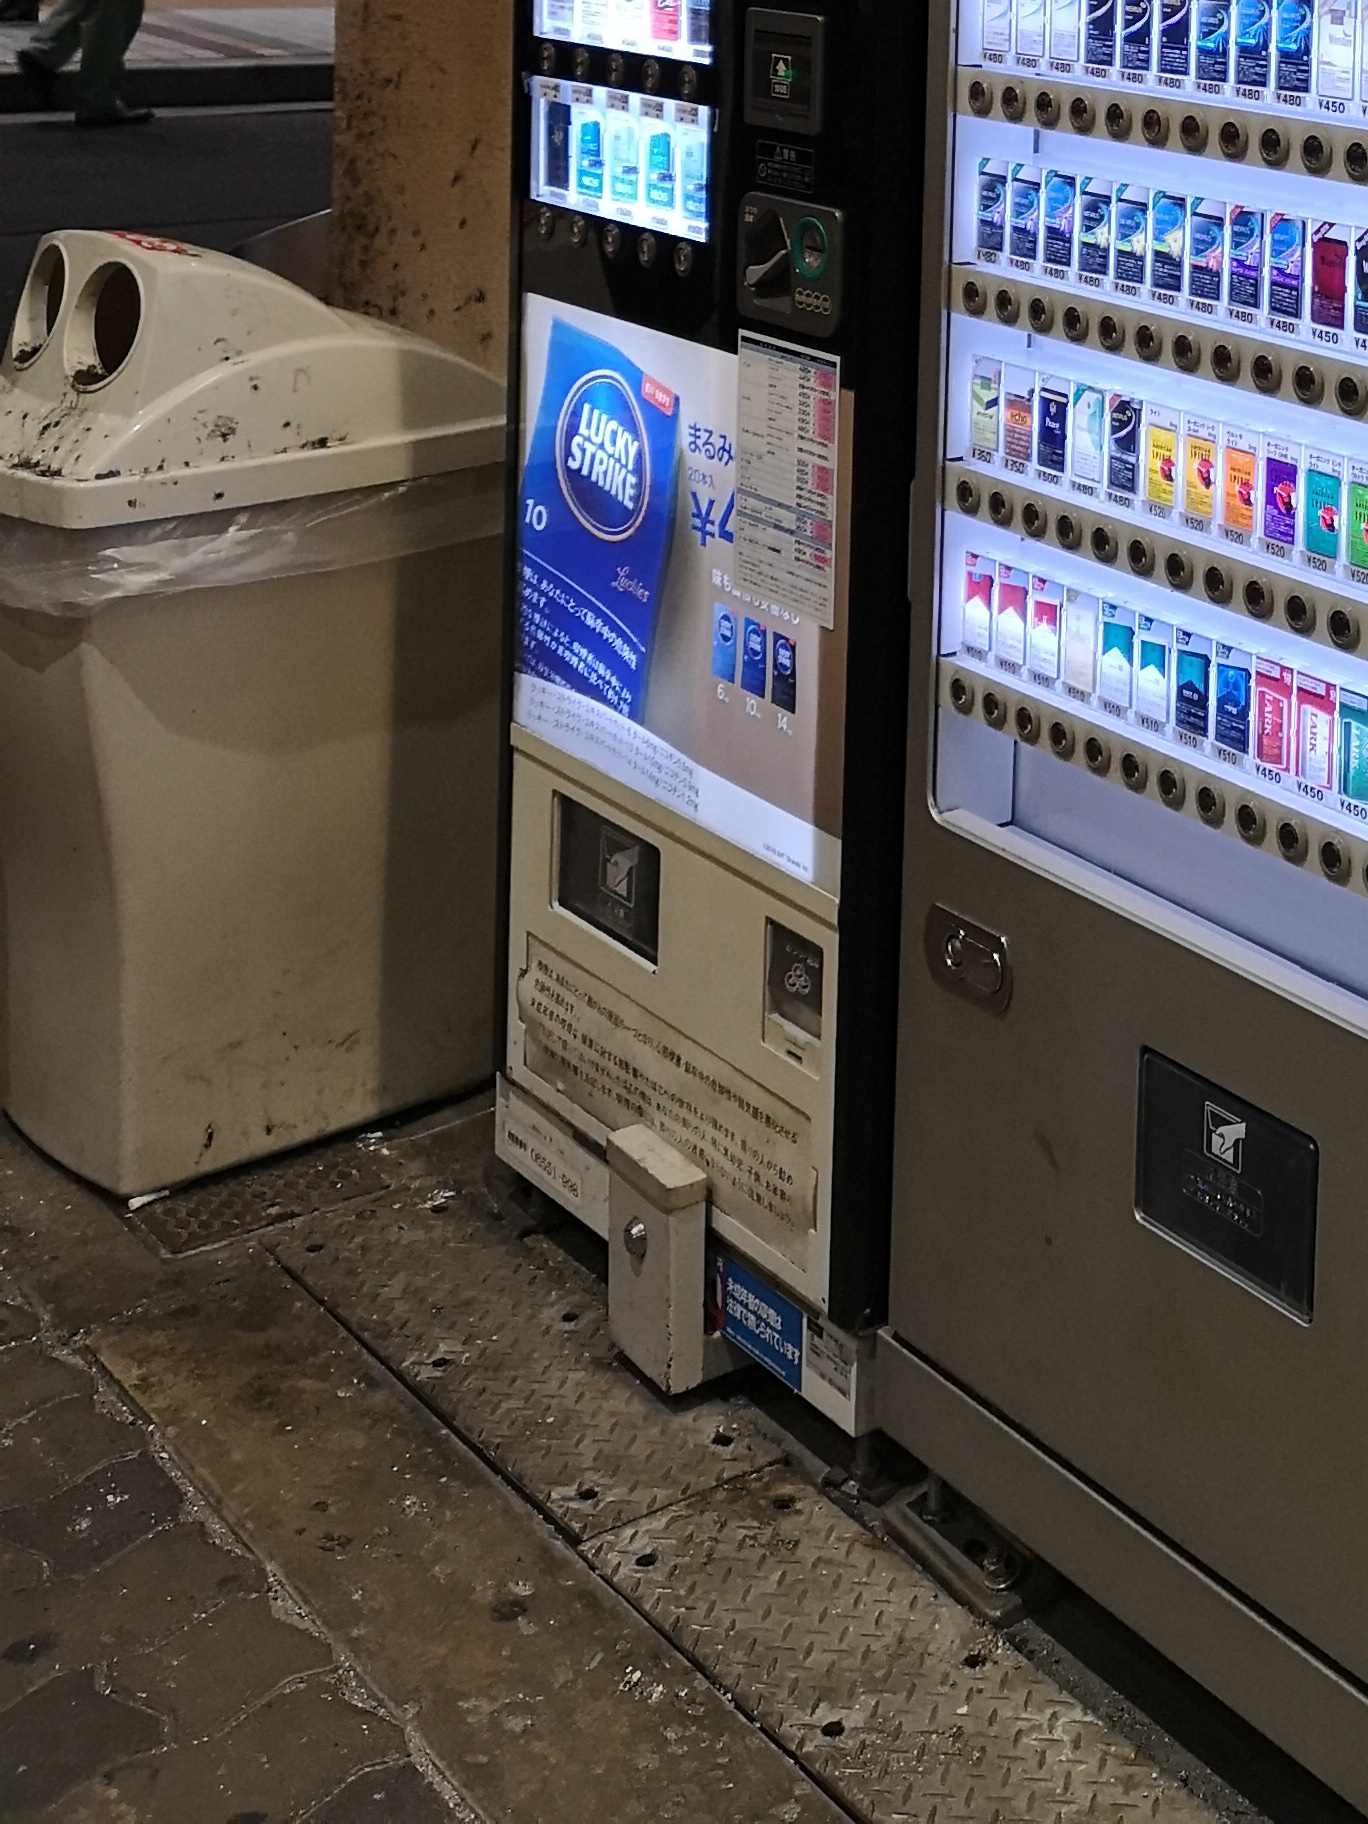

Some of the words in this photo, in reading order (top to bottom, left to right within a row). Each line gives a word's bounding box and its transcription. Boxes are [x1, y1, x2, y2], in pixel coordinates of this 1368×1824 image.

[577, 402, 640, 471] LUCKY
[1010, 410, 1028, 424] echo
[566, 435, 637, 511] STRIKE
[523, 498, 548, 531] 10
[1263, 693, 1273, 737] LARK
[1308, 712, 1317, 755] LARK
